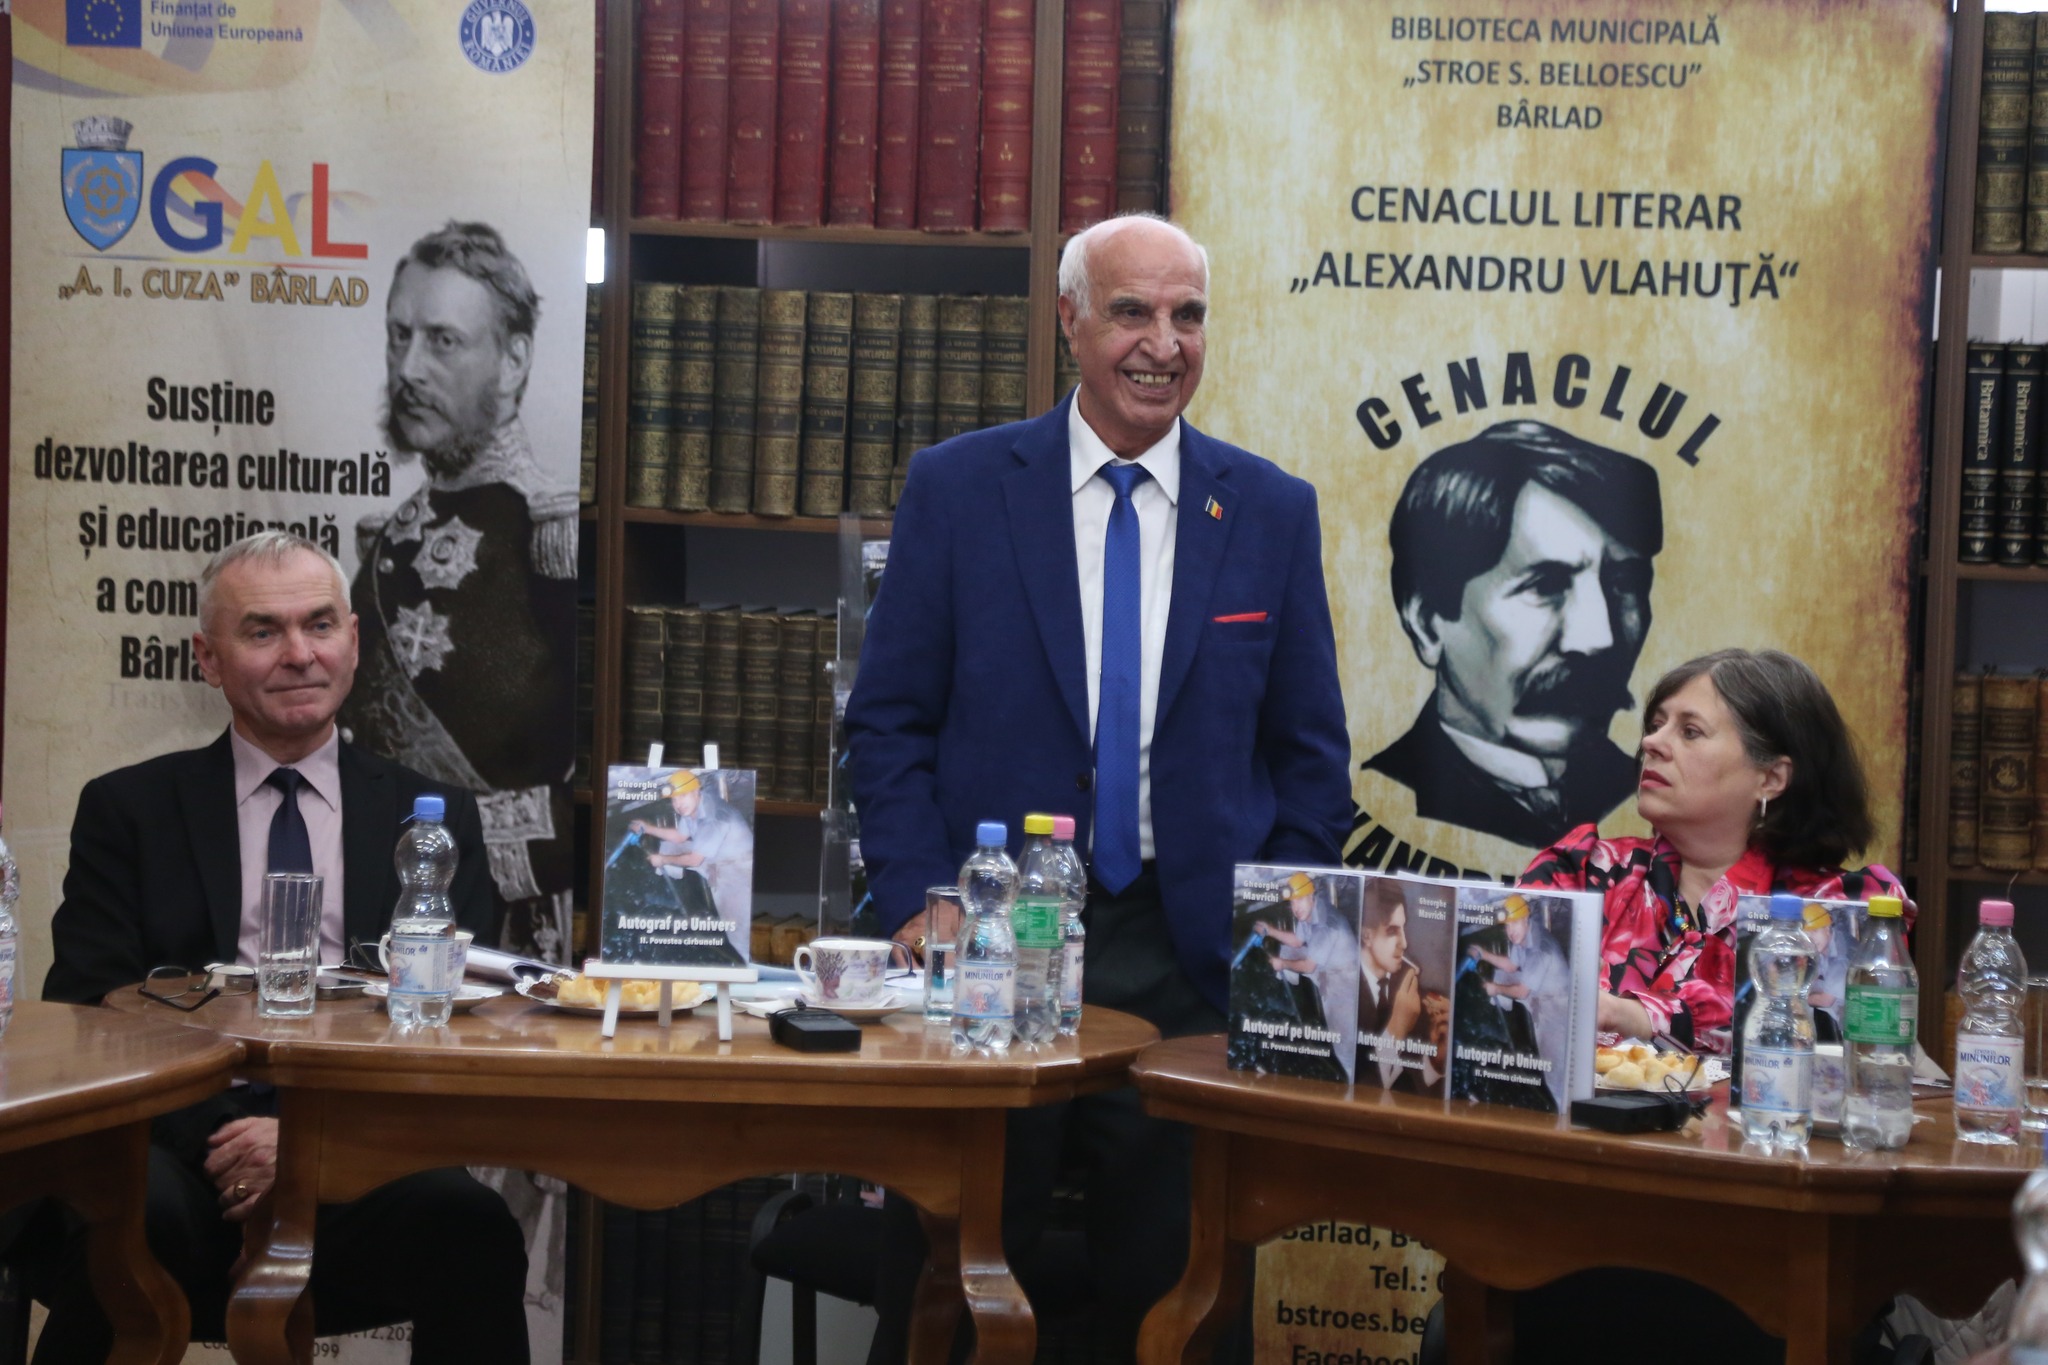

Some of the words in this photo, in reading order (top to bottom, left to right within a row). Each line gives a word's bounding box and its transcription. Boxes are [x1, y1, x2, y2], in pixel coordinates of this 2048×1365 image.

[217, 3, 237, 18] de
[151, 21, 214, 39] Uniunea
[1390, 16, 1542, 44] BIBLIOTECA
[1550, 14, 1720, 46] MUNICIPALĂ
[1403, 59, 1499, 88] „STROE
[1508, 61, 1529, 86] S.
[1540, 62, 1702, 88] BELLOESCU”
[1496, 98, 1603, 130] BÂRLAD
[150, 155, 368, 259] GAL
[1350, 185, 1560, 227] CENACLUL
[1573, 190, 1743, 231] LITERAR
[113, 266, 132, 298] I.
[250, 265, 369, 307] BÂRLAD
[1289, 251, 1566, 295] „ALEXANDRU
[147, 376, 275, 436] Susține
[1356, 352, 1721, 468] CENACLUL
[1977, 379, 1996, 461] Britannica
[2013, 380, 2032, 463] Britannica
[34, 437, 229, 488] dezvoltarea
[237, 448, 391, 498] culturală
[79, 505, 108, 561] și
[96, 577, 116, 613] a
[124, 578, 198, 617] com
[120, 635, 207, 682] Bârl
[617, 780, 658, 791] Gheorghe
[617, 791, 657, 801] Mavrichi
[1242, 891, 1279, 903] Mavrichi
[1243, 880, 1280, 891] Gheorghe
[1418, 909, 1446, 921] Mavrichi
[1419, 897, 1447, 909] Gheorghe
[1747, 911, 1772, 921] Gheo
[618, 915, 673, 934] Autograf
[673, 918, 688, 934] pe
[690, 916, 736, 932] Univers
[1458, 914, 1494, 926] Mavrichi
[649, 937, 683, 945] Povestea
[965, 970, 1004, 981] MINUNILOR
[1242, 1018, 1290, 1039] Autograf
[1290, 1026, 1303, 1041] pe
[1304, 1025, 1342, 1044] Univers
[1357, 1030, 1395, 1051] Autograf
[1395, 1039, 1406, 1055] pe
[1406, 1037, 1438, 1057] Univers
[1262, 1041, 1270, 1049] II.
[1270, 1042, 1298, 1053] Povestea
[1456, 1045, 1502, 1066] Autograf
[1502, 1053, 1515, 1070] pe
[1516, 1052, 1552, 1073] Univers
[1960, 1052, 2011, 1067] MINUNILOR
[1483, 1070, 1510, 1082] Povestea
[1369, 1264, 1428, 1293] Tel.:
